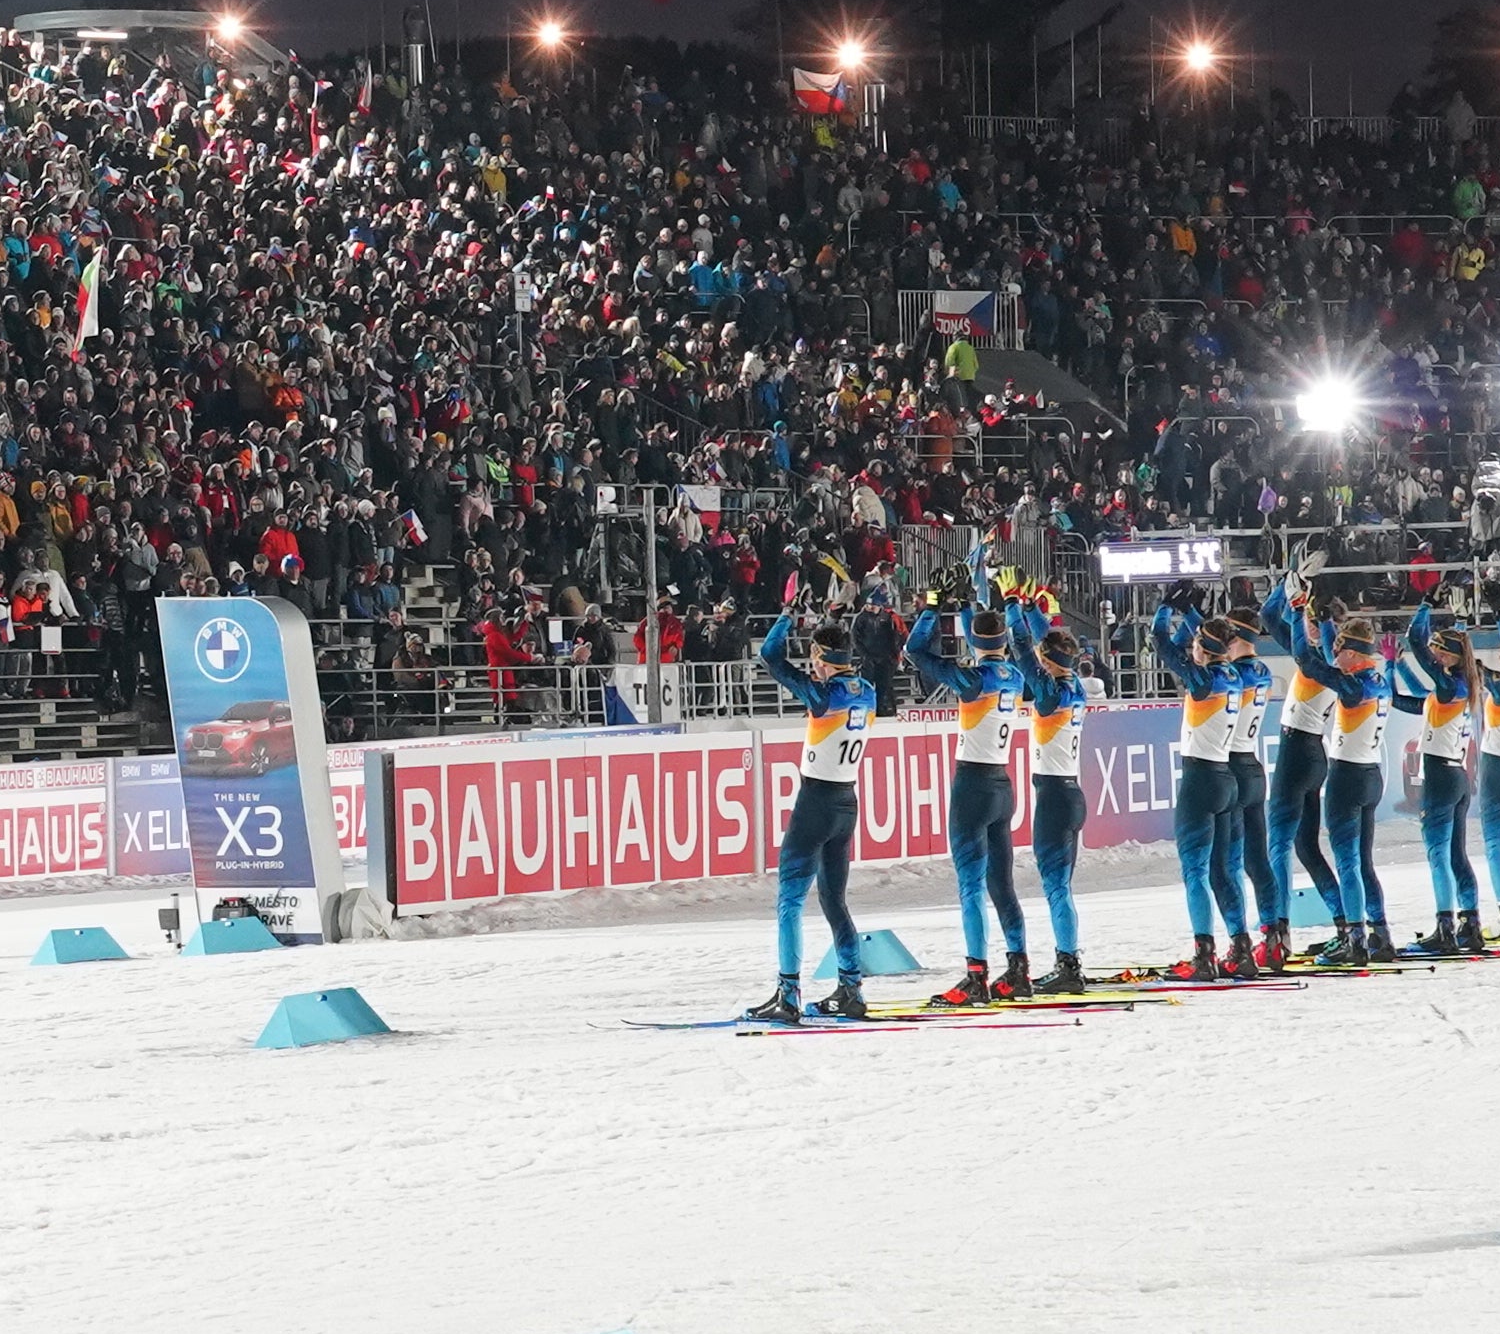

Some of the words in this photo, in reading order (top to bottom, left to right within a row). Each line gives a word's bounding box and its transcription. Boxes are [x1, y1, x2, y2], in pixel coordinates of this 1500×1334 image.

[202, 620, 243, 640] BMW
[633, 678, 673, 707] TČ
[1322, 700, 1335, 723] 4
[998, 723, 1009, 749] 9
[1223, 724, 1234, 748] 7
[1247, 716, 1260, 739] 6
[1372, 726, 1382, 749] 5
[838, 739, 863, 765] 10
[46, 764, 105, 787] BAUHAUS
[121, 764, 141, 777] BMW
[151, 762, 171, 775] BMW
[1094, 747, 1120, 816] X
[214, 793, 234, 802] THE
[238, 793, 261, 802] NEW
[123, 812, 143, 854] X
[215, 805, 284, 857] X3
[402, 767, 749, 882] BAUHAUS
[215, 860, 285, 870] PLUG-IN-HYBRID
[261, 912, 295, 926] RAVĚ
